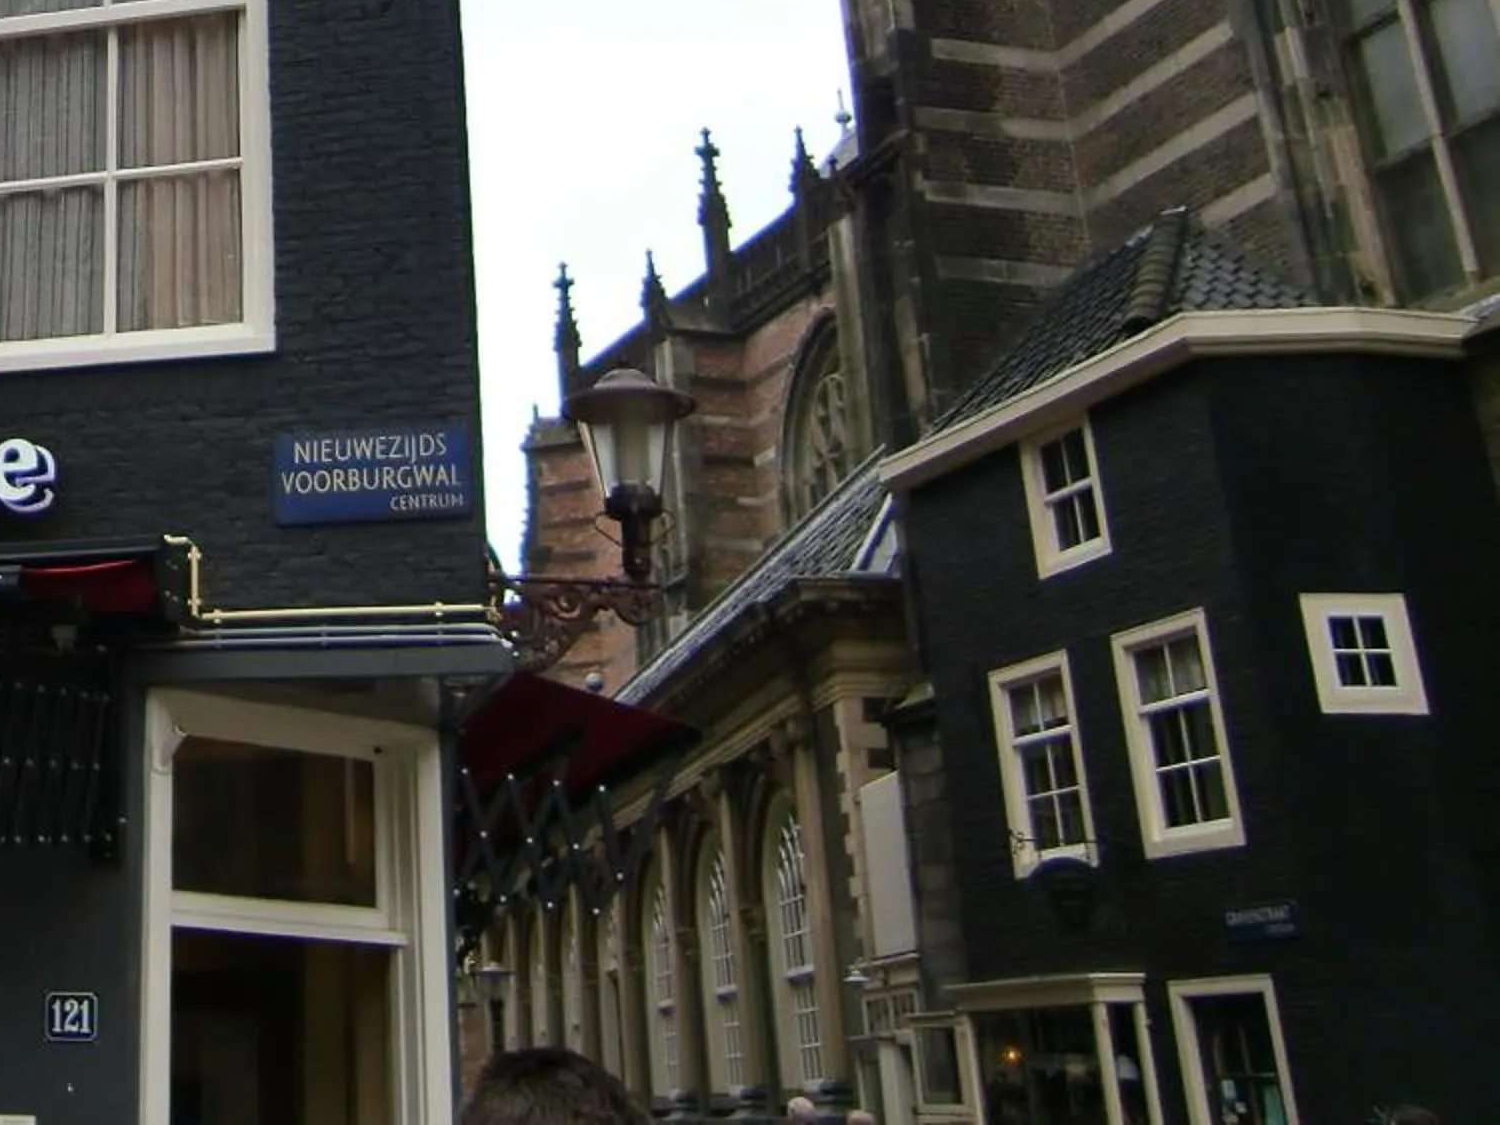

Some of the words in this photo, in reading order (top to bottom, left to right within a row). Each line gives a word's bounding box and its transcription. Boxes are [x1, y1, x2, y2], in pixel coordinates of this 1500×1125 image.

[293, 433, 448, 463] NIEUWEZIJDS
[281, 464, 463, 494] VOORBURGWAL
[390, 492, 465, 511] CENTRUM
[52, 999, 92, 1033] 121
